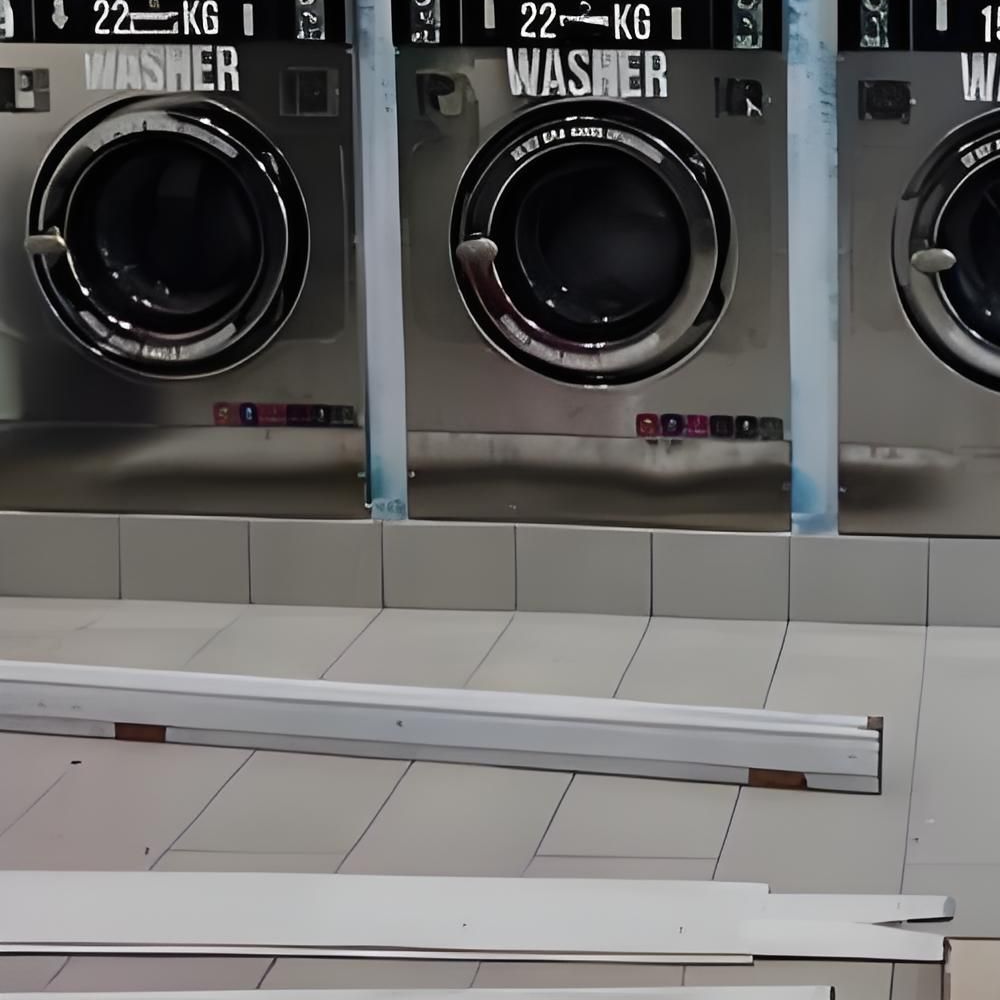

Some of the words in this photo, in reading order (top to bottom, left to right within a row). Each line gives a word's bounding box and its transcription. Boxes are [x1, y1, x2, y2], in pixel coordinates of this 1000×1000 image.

[94, 0, 130, 36] 22
[183, 0, 219, 36] KG
[520, 1, 558, 39] 22
[613, 3, 651, 41] KG
[85, 44, 240, 93] WASHER
[506, 47, 668, 99] WASHER
